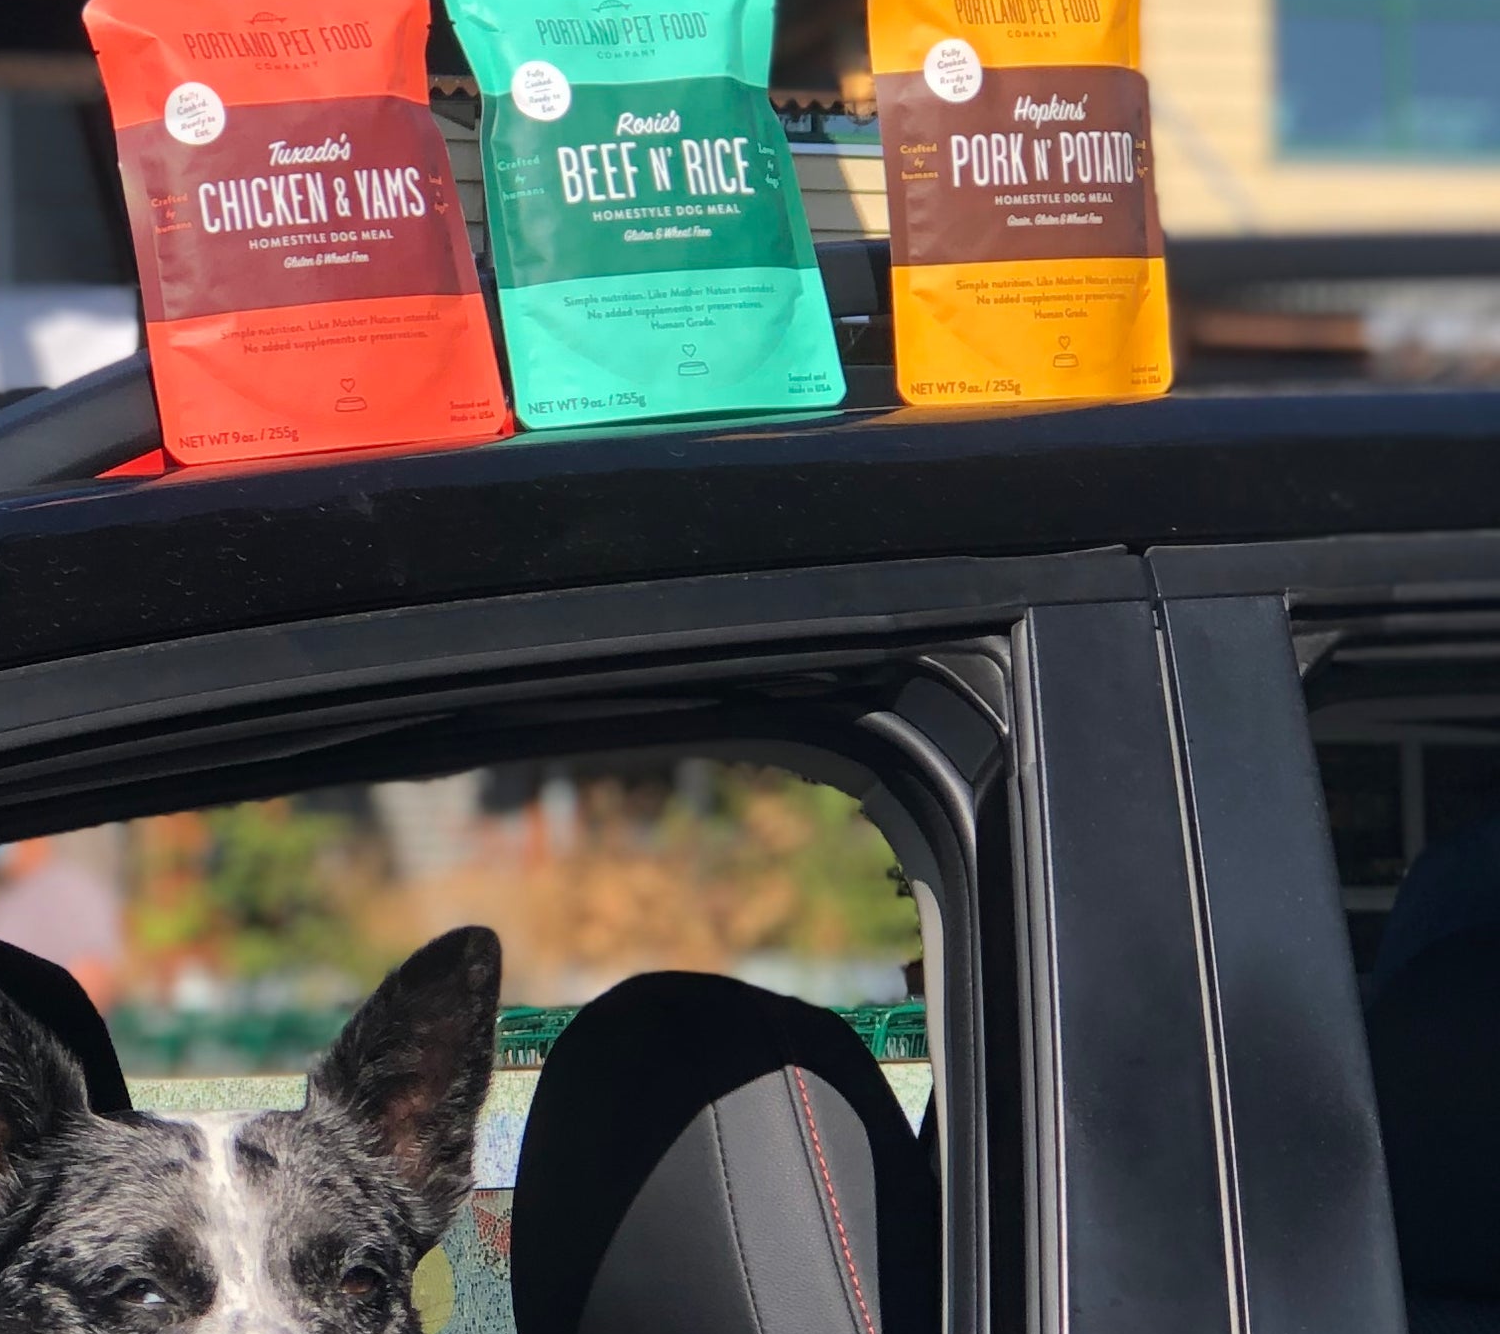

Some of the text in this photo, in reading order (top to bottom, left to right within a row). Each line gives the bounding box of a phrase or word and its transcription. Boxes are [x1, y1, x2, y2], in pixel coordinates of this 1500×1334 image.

[535, 19, 620, 45] PORTLAND
[622, 15, 655, 44] PET
[1008, 30, 1056, 38] COMPANY
[183, 31, 277, 59] PORTLAND
[278, 29, 316, 56] PET
[597, 49, 656, 59] COMPANY
[942, 48, 960, 58] Fully
[255, 61, 319, 70] COMPANY
[1014, 93, 1088, 129] Hopkins'
[616, 110, 680, 136] Rosie's
[269, 133, 351, 167] Tuxedo's
[900, 143, 937, 154] Crafted
[497, 155, 540, 171] Crafted
[951, 133, 1028, 187] PORK
[1034, 139, 1052, 181] N'
[1059, 131, 1134, 183] POTATO
[557, 138, 755, 204] BEEF N' RICE
[901, 171, 939, 180] humans
[151, 193, 188, 207] Crafted
[198, 172, 328, 233] CHICKEN
[333, 177, 351, 217] &
[354, 167, 426, 219] YAMS
[502, 188, 545, 201] humans
[995, 193, 1113, 205] HOMESTYLE DOG MEAL
[593, 204, 741, 221] HOMESTYLE DOG MEAL
[155, 222, 192, 234] humans
[624, 229, 654, 241] Gluten
[249, 229, 394, 249] HOMESTYLE DOG MEAL
[284, 255, 314, 268] Gluten
[324, 253, 350, 264] Wheat
[956, 280, 988, 292] Simple
[564, 296, 599, 308] Simple
[648, 290, 667, 299] Like
[670, 288, 702, 297] Mother
[706, 286, 736, 295] Nature
[977, 296, 990, 305] No
[993, 294, 1020, 304] added
[1023, 293, 1073, 305] supplements
[588, 310, 602, 320] No
[605, 307, 632, 317] added
[636, 305, 692, 319] supplements
[695, 304, 705, 312] or
[1034, 310, 1063, 319] Human
[221, 327, 255, 339] Simple
[308, 321, 329, 330] Like
[333, 316, 368, 328] Mother
[370, 315, 401, 325] Nature
[651, 320, 684, 330] Human
[244, 344, 258, 354] No
[262, 340, 291, 352] added
[293, 337, 356, 351] supplements
[910, 383, 933, 395] NET
[936, 382, 956, 393] WT
[986, 381, 990, 392] /
[993, 380, 1021, 395] 255g
[528, 401, 553, 414] NET
[557, 398, 577, 411] WT
[609, 395, 612, 406] /
[616, 392, 646, 407] 255g
[179, 435, 205, 448] NET
[208, 433, 229, 445] WT
[261, 428, 264, 440] /
[268, 426, 299, 442] 255g
